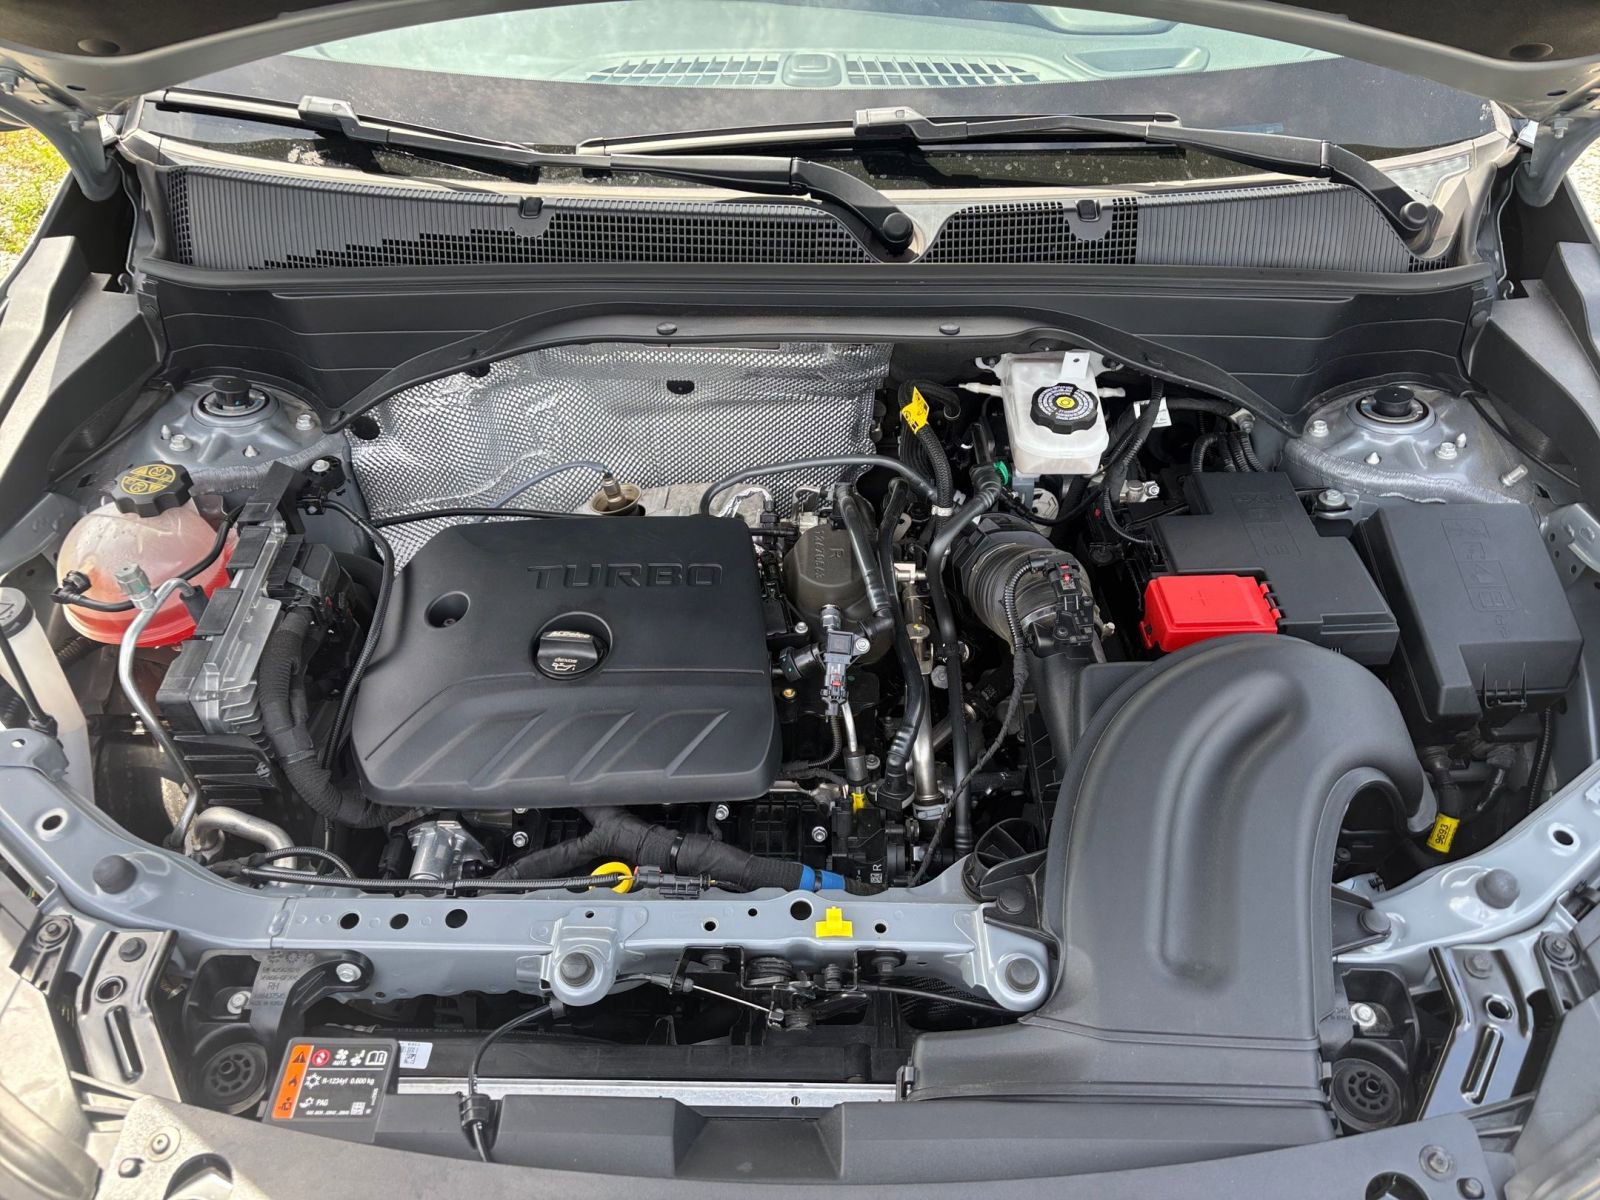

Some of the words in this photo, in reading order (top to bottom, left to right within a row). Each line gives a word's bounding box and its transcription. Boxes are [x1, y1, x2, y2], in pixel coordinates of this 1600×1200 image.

[830, 547, 845, 560] R
[527, 563, 722, 589] TURBO
[1435, 824, 1448, 845] 9693
[267, 982, 280, 990] RH
[367, 1078, 375, 1086] kg
